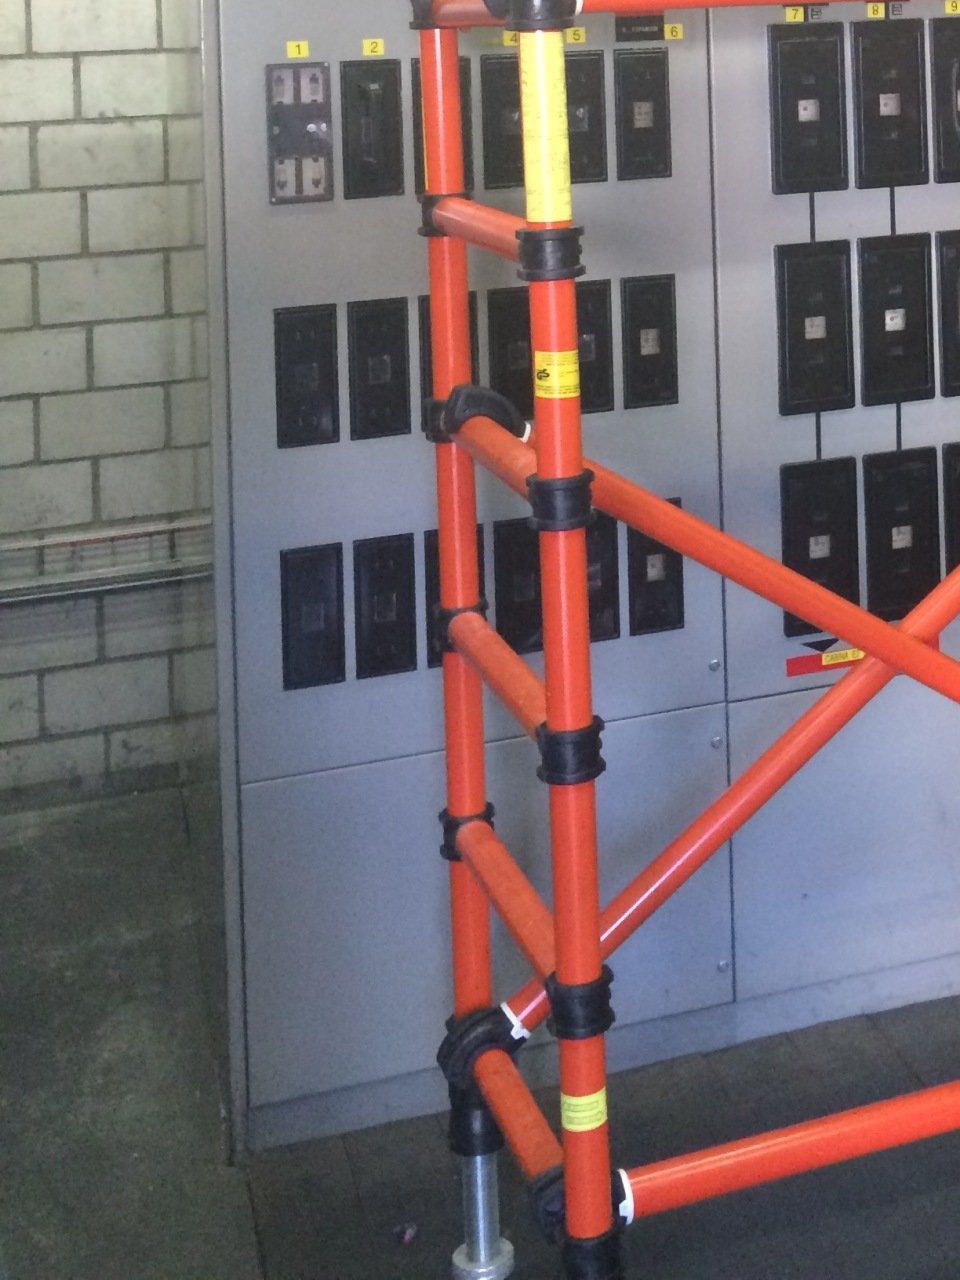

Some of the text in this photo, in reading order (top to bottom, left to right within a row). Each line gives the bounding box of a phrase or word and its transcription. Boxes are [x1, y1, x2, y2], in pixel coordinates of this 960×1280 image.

[791, 8, 799, 20] 7
[871, 5, 879, 15] 8
[572, 29, 581, 41] 5
[670, 26, 678, 38] 6
[370, 41, 378, 54] 2
